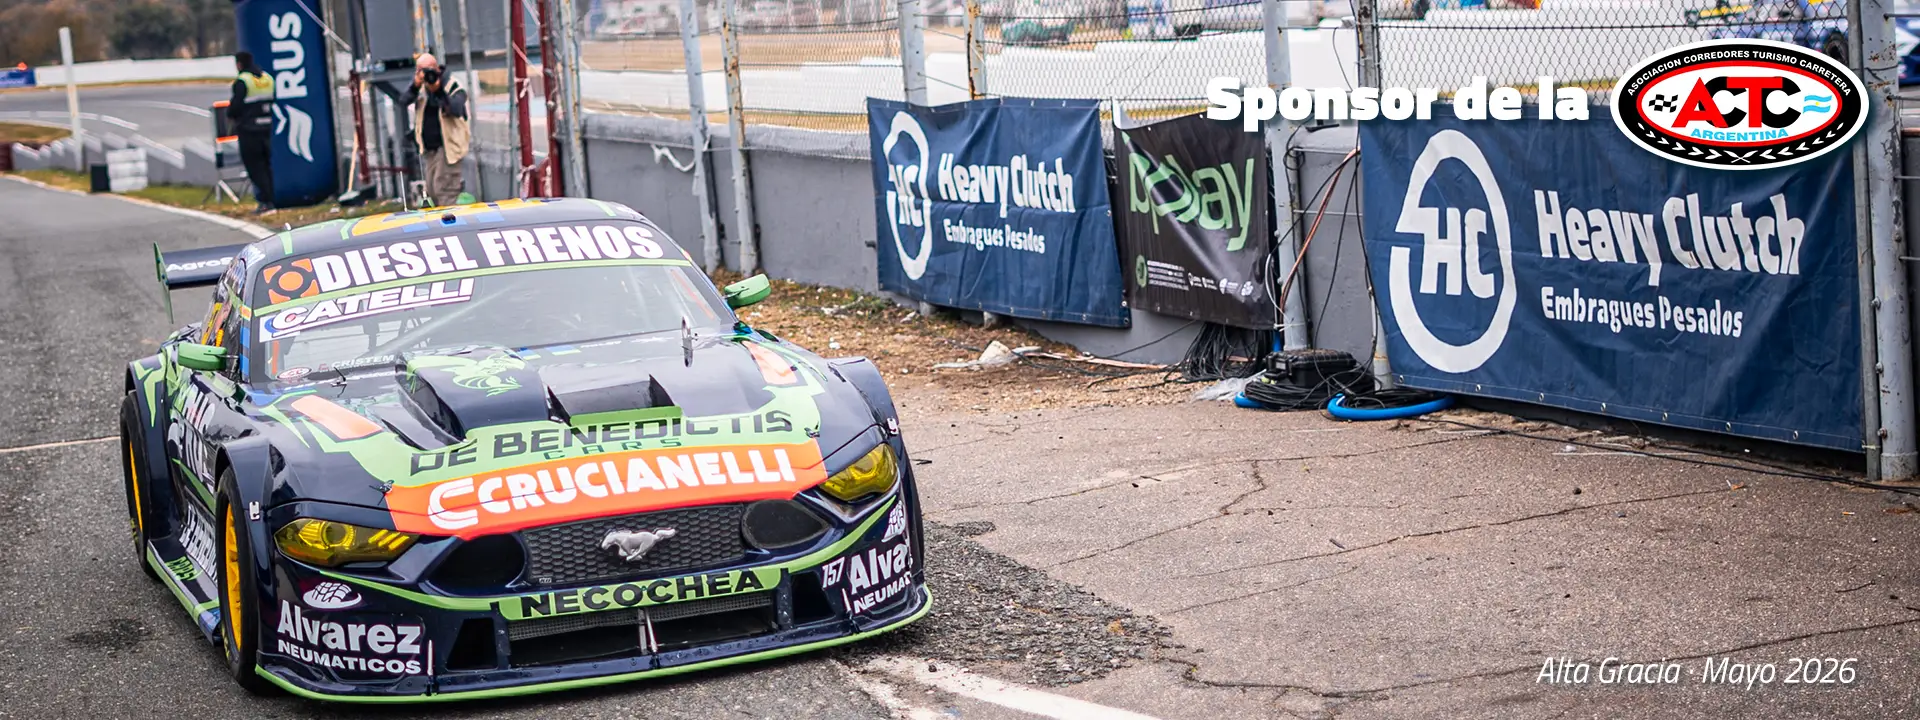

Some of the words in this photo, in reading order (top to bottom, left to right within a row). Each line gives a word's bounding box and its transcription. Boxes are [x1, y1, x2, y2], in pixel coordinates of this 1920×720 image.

[269, 11, 308, 99] RUS
[938, 153, 1009, 218] Heavy
[1010, 154, 1076, 213] Clutch
[313, 236, 479, 293] DIESEL
[476, 225, 665, 266] FRENOS
[943, 218, 1004, 251] Embragues
[1005, 224, 1046, 255] Pesados
[1533, 189, 1660, 287] Heavy
[1662, 191, 1805, 276] Clutch
[271, 278, 474, 332] CATELLI
[1541, 287, 1656, 334] Embragues
[1658, 296, 1744, 338] Pesados
[410, 438, 478, 476] DE
[493, 410, 793, 459] BENEDICTIS
[543, 438, 683, 460] CARS
[477, 448, 797, 512] CRUCIANELLI
[520, 569, 767, 618] NECOCHEA
[822, 556, 845, 589] 157
[850, 543, 909, 595] Alva
[853, 571, 912, 614] NEUMAT
[277, 599, 421, 655] Alvarez
[277, 639, 422, 675] NEUMATICOS
